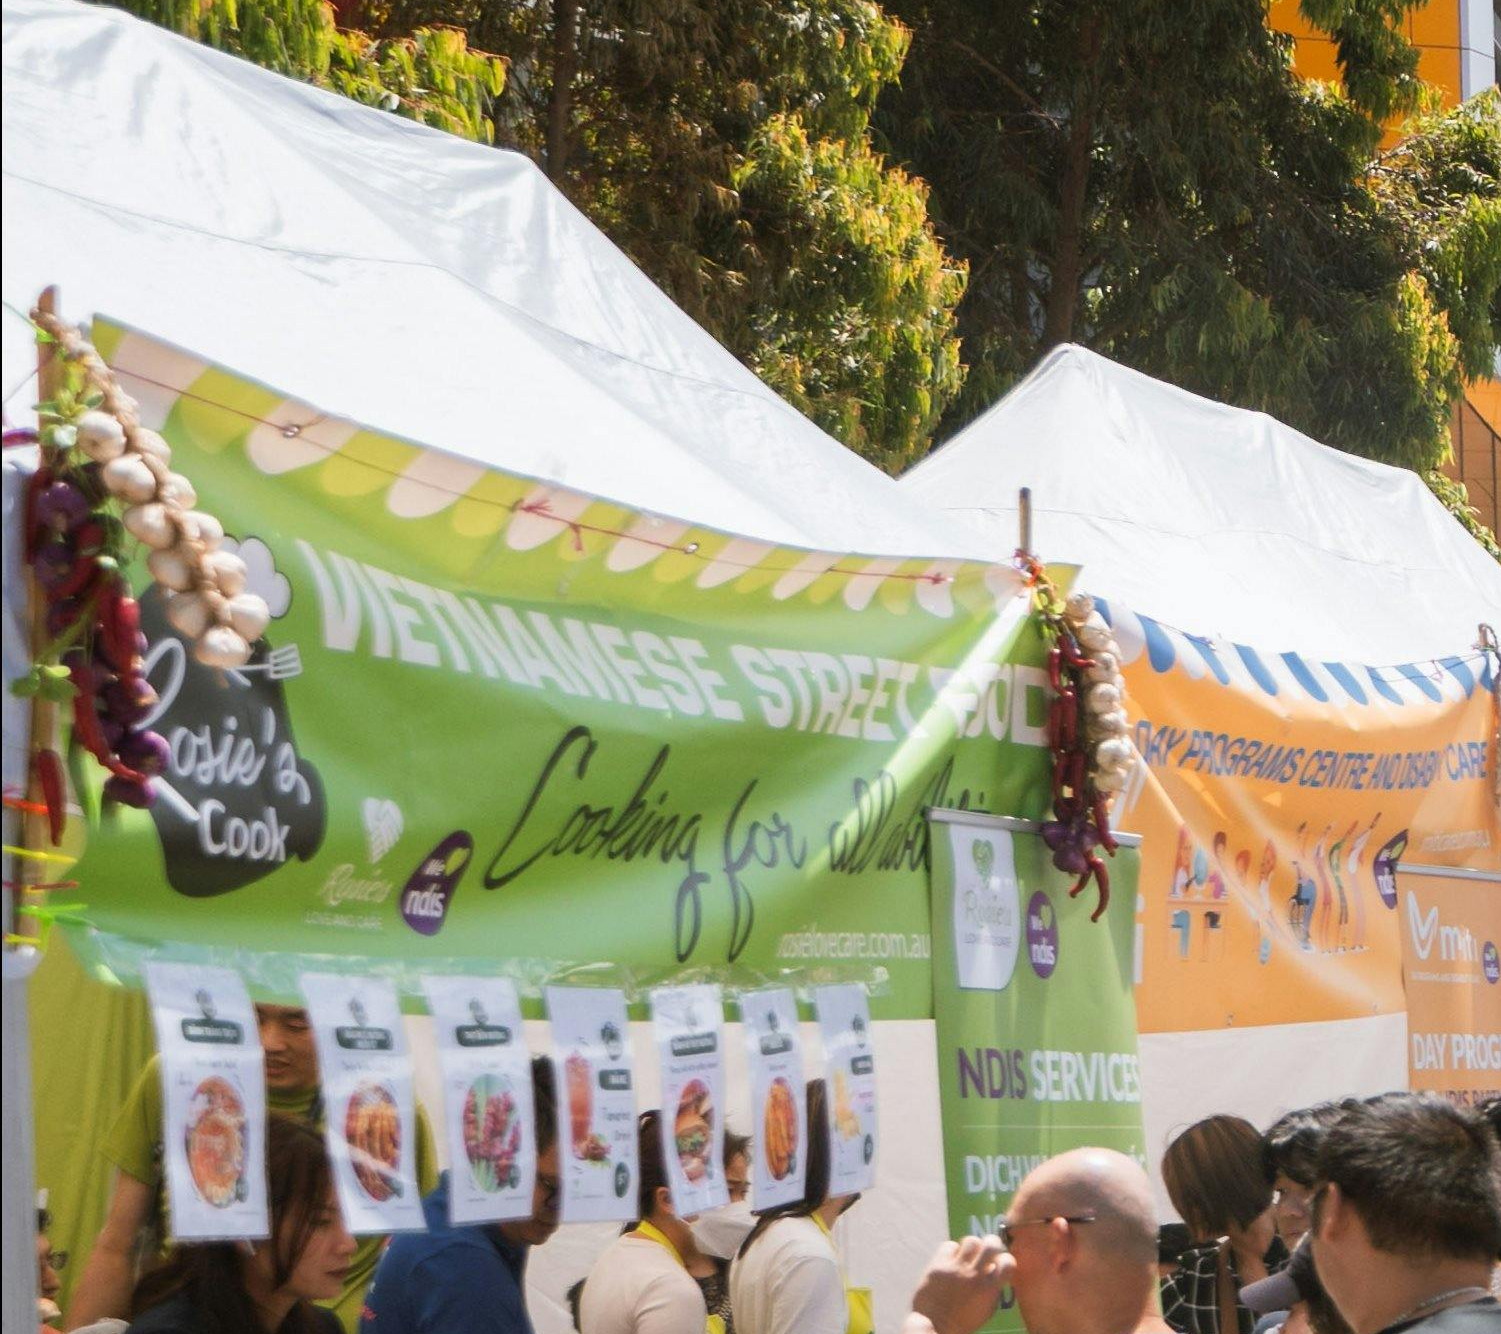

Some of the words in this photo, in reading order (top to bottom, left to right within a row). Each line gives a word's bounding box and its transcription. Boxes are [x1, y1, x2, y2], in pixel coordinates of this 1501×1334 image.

[300, 540, 743, 723] VIETNAMESE
[729, 644, 928, 744] STREET
[1133, 719, 1186, 766] DAY
[1180, 730, 1304, 784] PROGRAMS
[1300, 747, 1374, 789] CENTRE
[1445, 741, 1488, 781] CARE
[199, 798, 291, 863] Cook
[484, 725, 700, 963] Cooking
[722, 777, 807, 963] for
[404, 882, 446, 917] ndis
[957, 1048, 1027, 1099] NDIS
[1030, 1051, 1142, 1103] SERVICES
[1412, 1033, 1447, 1070] DAY
